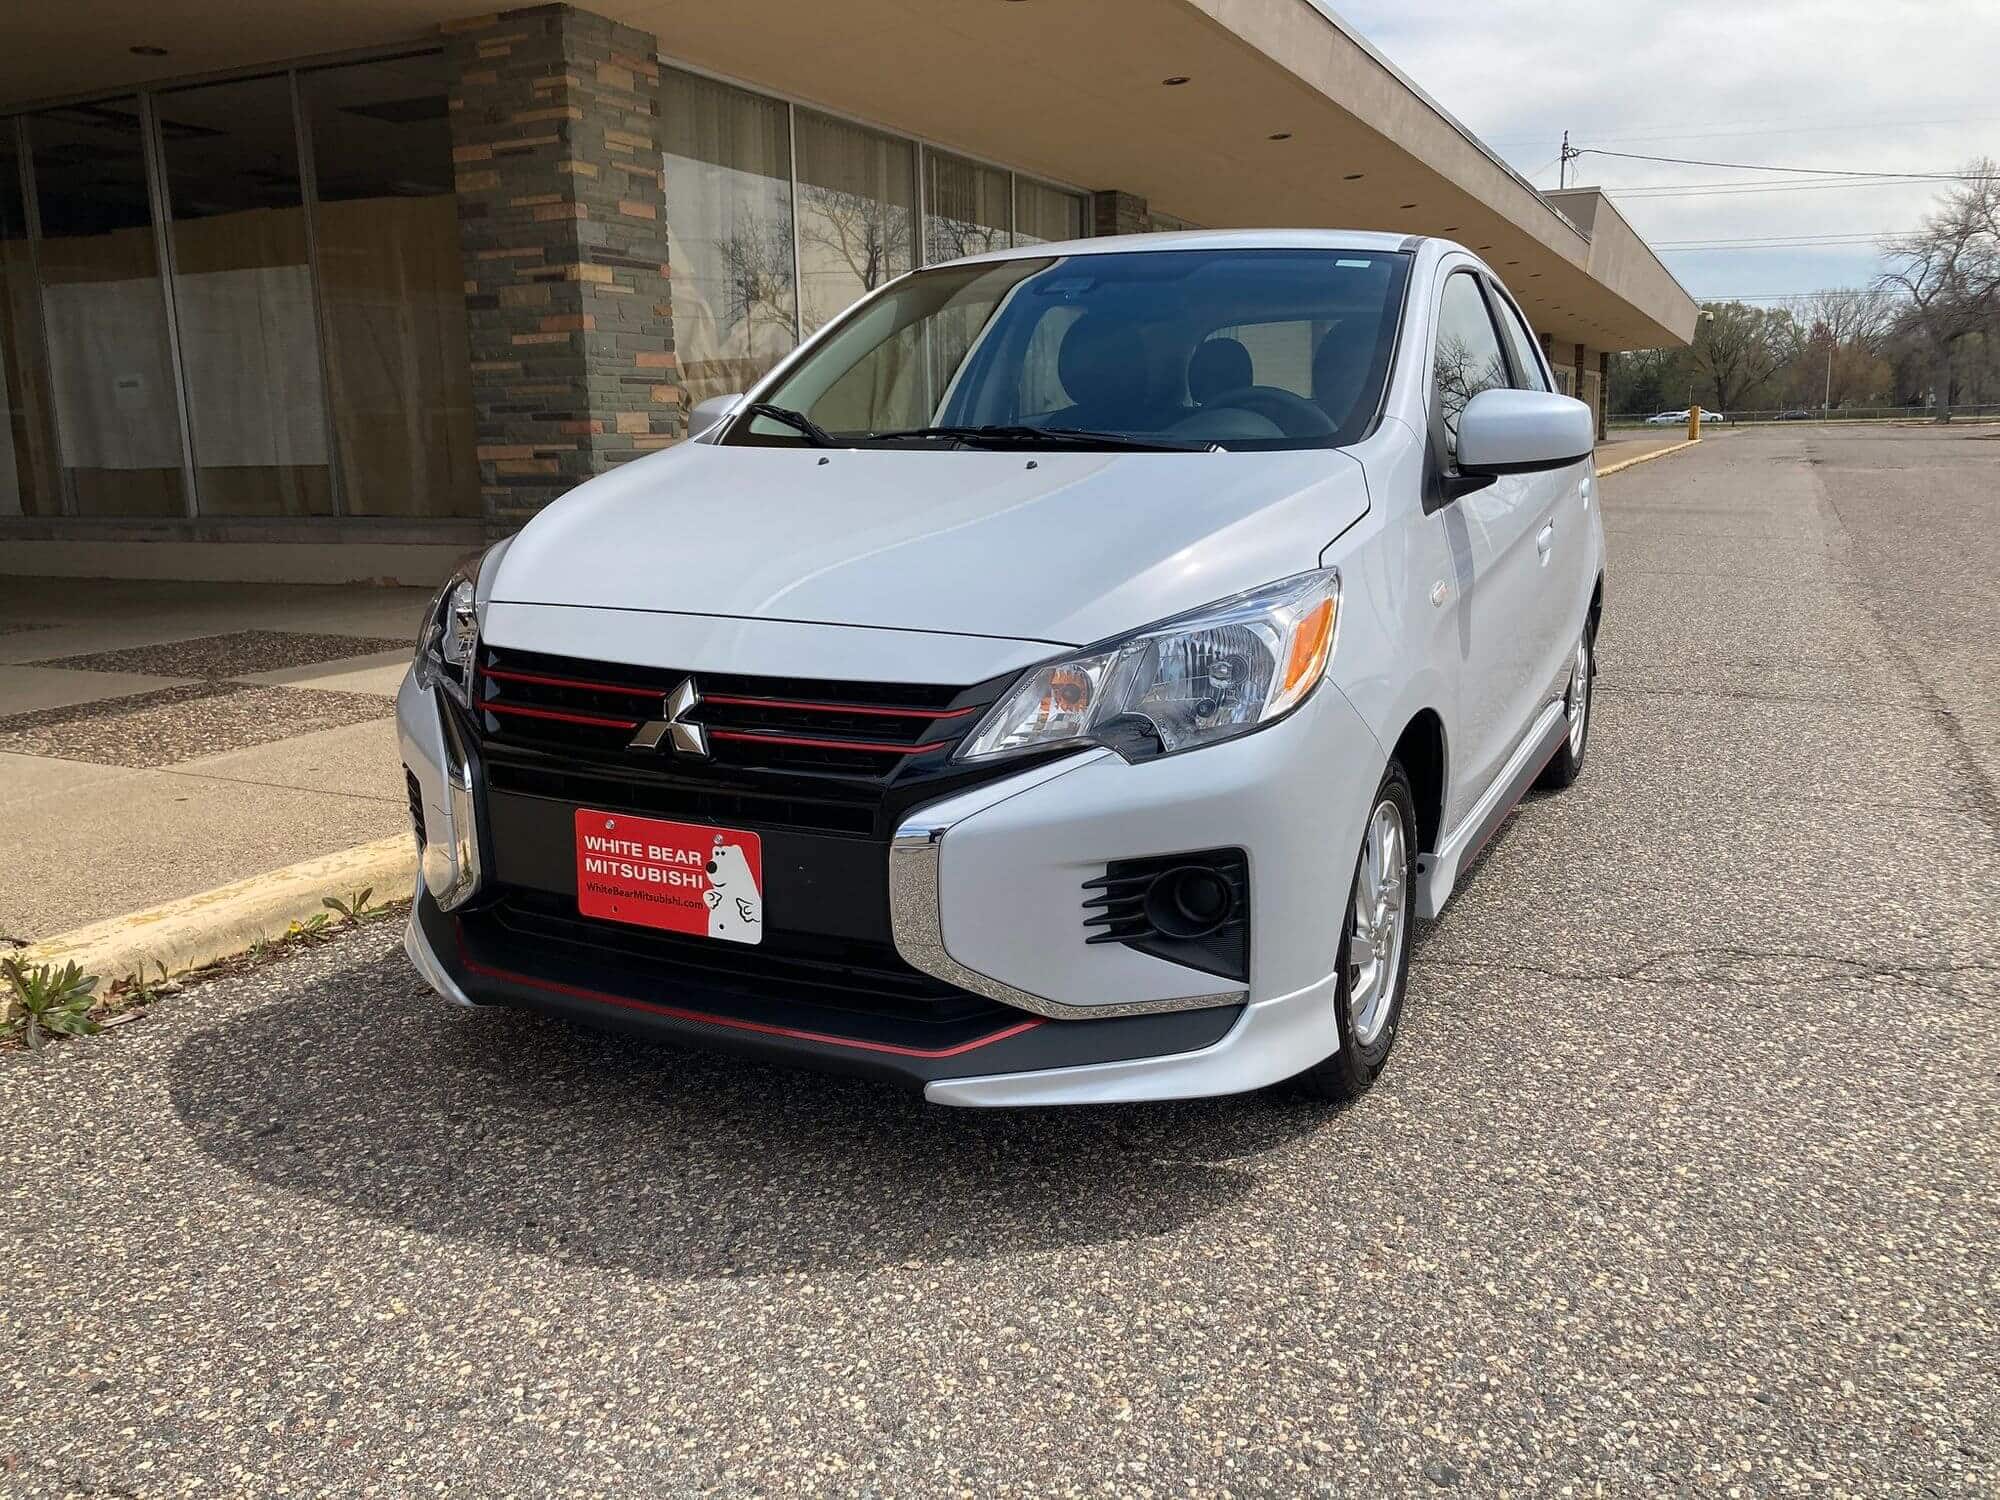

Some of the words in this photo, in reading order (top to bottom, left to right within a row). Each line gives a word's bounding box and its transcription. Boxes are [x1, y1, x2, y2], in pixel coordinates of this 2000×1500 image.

[584, 835, 643, 858] WHITE
[648, 845, 702, 866] BEAR
[585, 857, 703, 889] MITSUBISHI
[587, 882, 704, 910] WhiteBearMitsubishi.com
